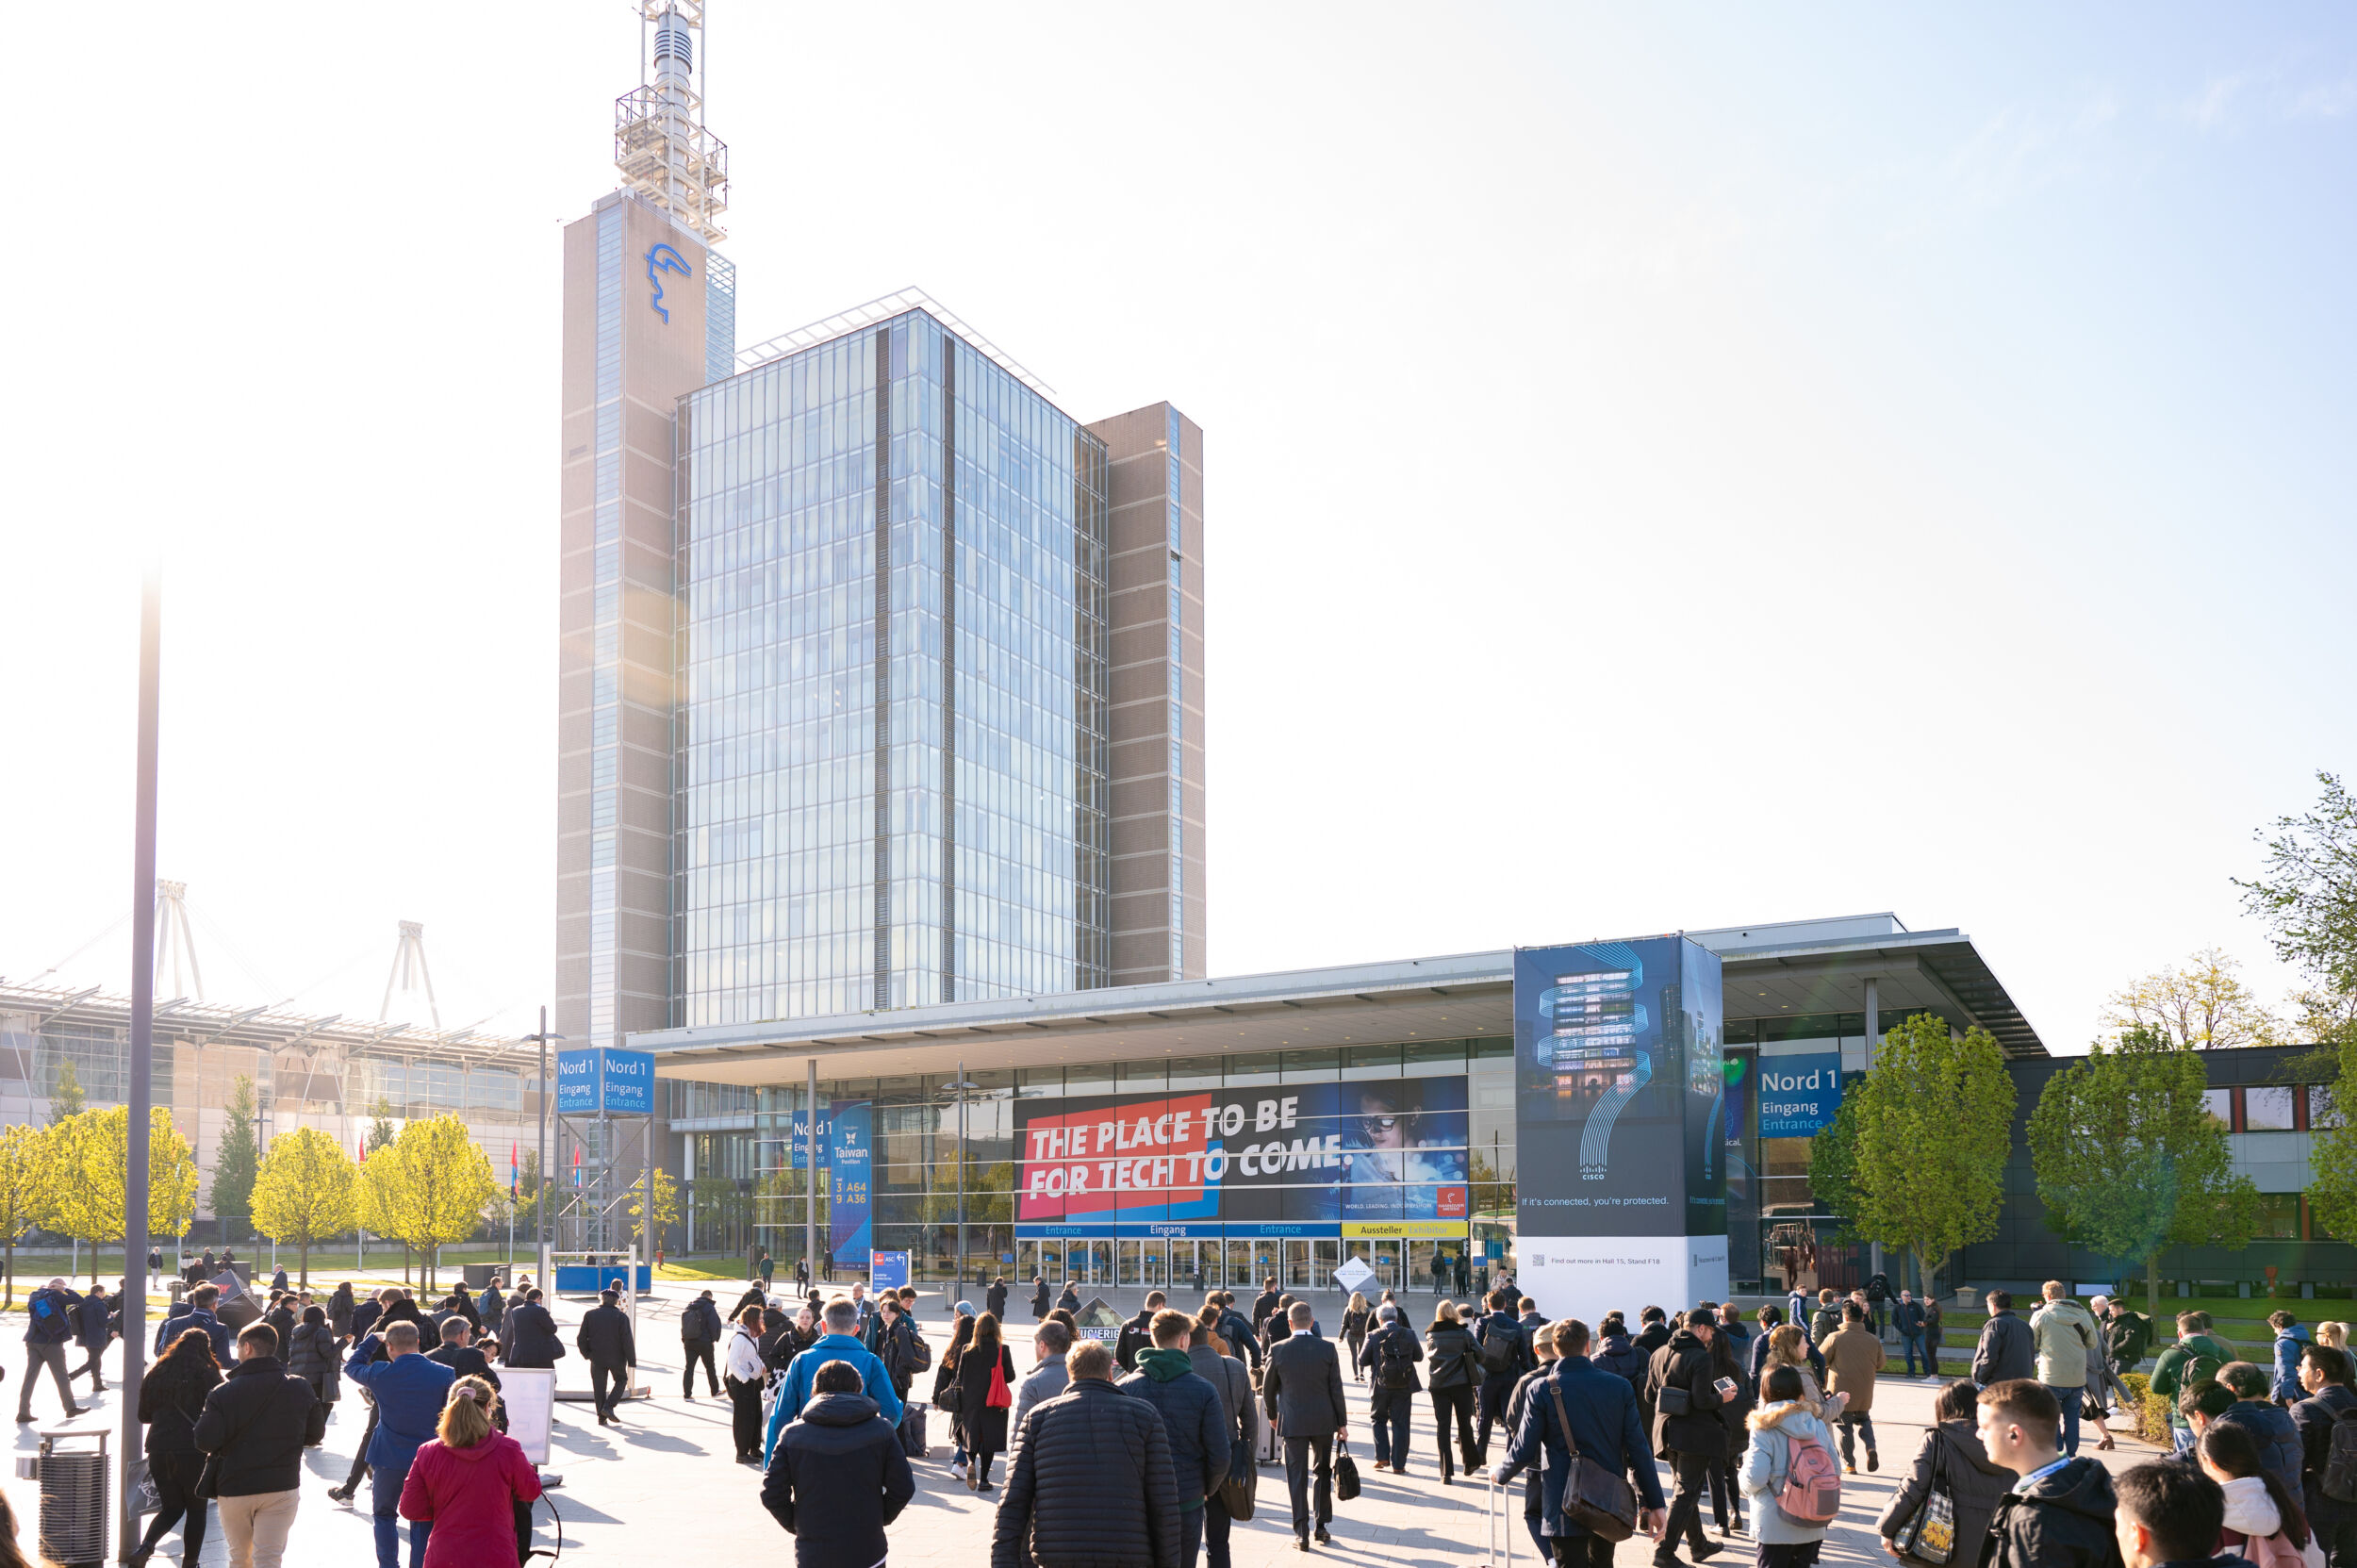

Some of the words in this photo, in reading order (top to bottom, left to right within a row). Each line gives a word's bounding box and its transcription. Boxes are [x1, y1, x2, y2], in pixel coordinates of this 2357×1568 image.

[559, 1060, 585, 1075] Nord
[588, 1059, 593, 1072] 1
[605, 1059, 637, 1075] Nord
[640, 1063, 646, 1076] 1
[1761, 1069, 1820, 1092] Nord
[1827, 1069, 1836, 1089] 1
[559, 1084, 591, 1097] Eingang
[605, 1081, 643, 1098] Eingang
[559, 1098, 593, 1108] Entrance
[605, 1096, 646, 1108] Entrance
[1762, 1101, 1819, 1116] Eingang
[794, 1120, 824, 1136] Nod
[827, 1120, 832, 1134] 1
[1032, 1125, 1088, 1160] THE
[1096, 1111, 1191, 1152] PLACE
[1201, 1103, 1245, 1139] TO
[1255, 1096, 1298, 1132] BE
[1763, 1119, 1823, 1131] Entrance
[794, 1143, 823, 1154] Eingng
[834, 1146, 868, 1159] Taiwan
[794, 1155, 825, 1164] Entrce
[1030, 1164, 1089, 1200] FOR
[1098, 1154, 1177, 1190] TECH
[1186, 1147, 1229, 1182] TO
[1239, 1134, 1354, 1177] COME.
[836, 1182, 843, 1193] 3
[846, 1182, 866, 1193] A64
[836, 1194, 843, 1204] 9
[846, 1194, 866, 1204] A36
[1522, 1197, 1527, 1206] If
[1529, 1197, 1542, 1206] it's
[1543, 1197, 1591, 1207] connected,
[1593, 1197, 1621, 1207] you're
[1623, 1197, 1670, 1207] protected.
[1046, 1227, 1082, 1235] Entrance
[1150, 1225, 1186, 1237] Eingang
[1260, 1224, 1302, 1234] Entrance
[1360, 1226, 1403, 1234] Aussteller
[1409, 1225, 1448, 1234] Exhibitor
